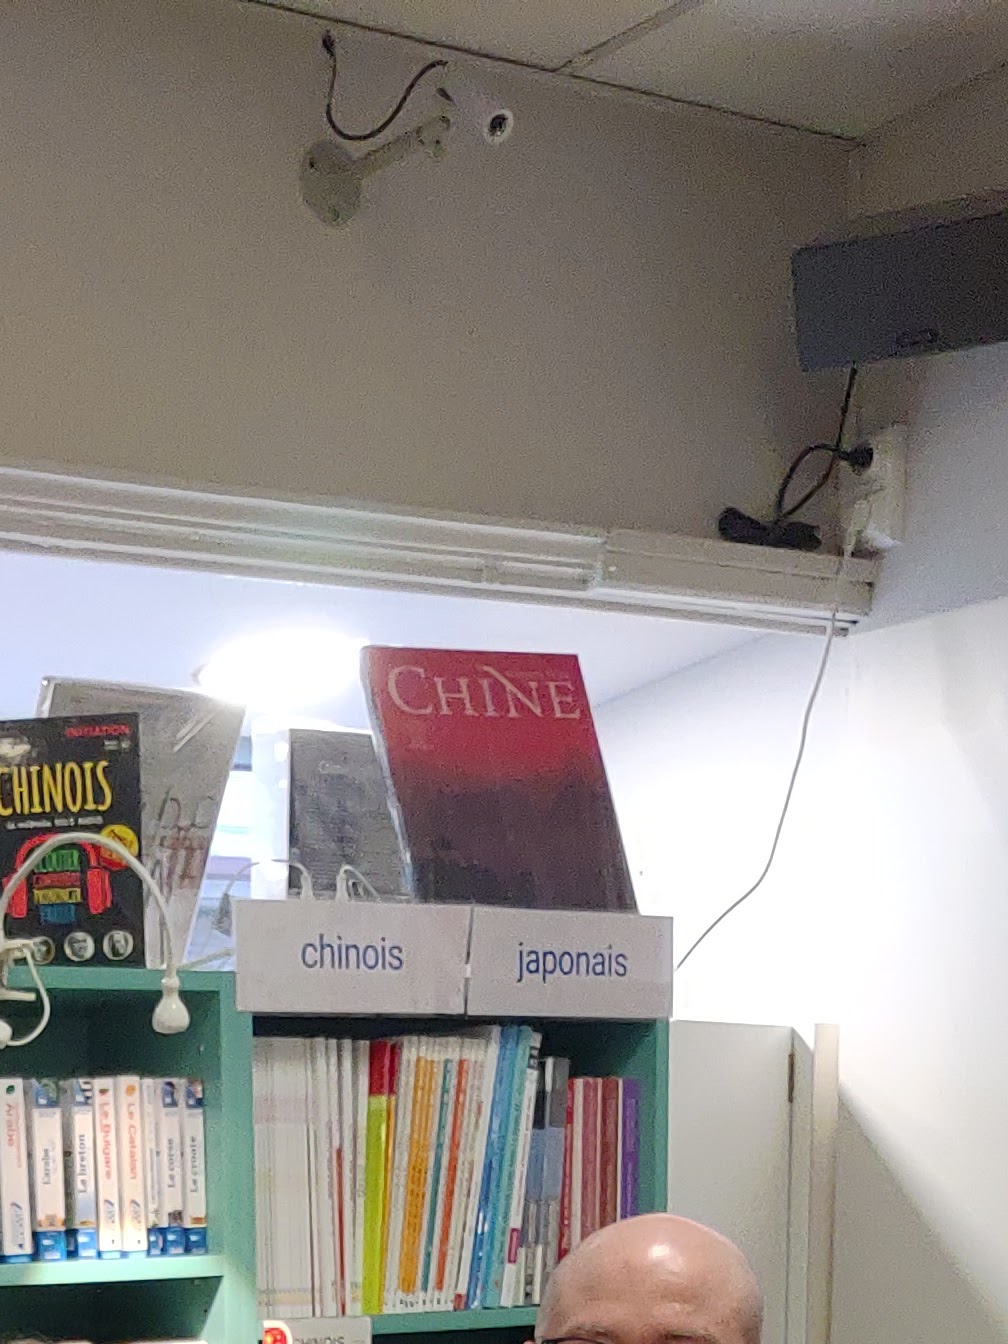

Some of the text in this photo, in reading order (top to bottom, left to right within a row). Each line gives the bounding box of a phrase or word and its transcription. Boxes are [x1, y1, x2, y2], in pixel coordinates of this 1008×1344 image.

[387, 664, 580, 720] CHINE
[301, 934, 404, 972] chinois
[517, 942, 629, 984] japonais
